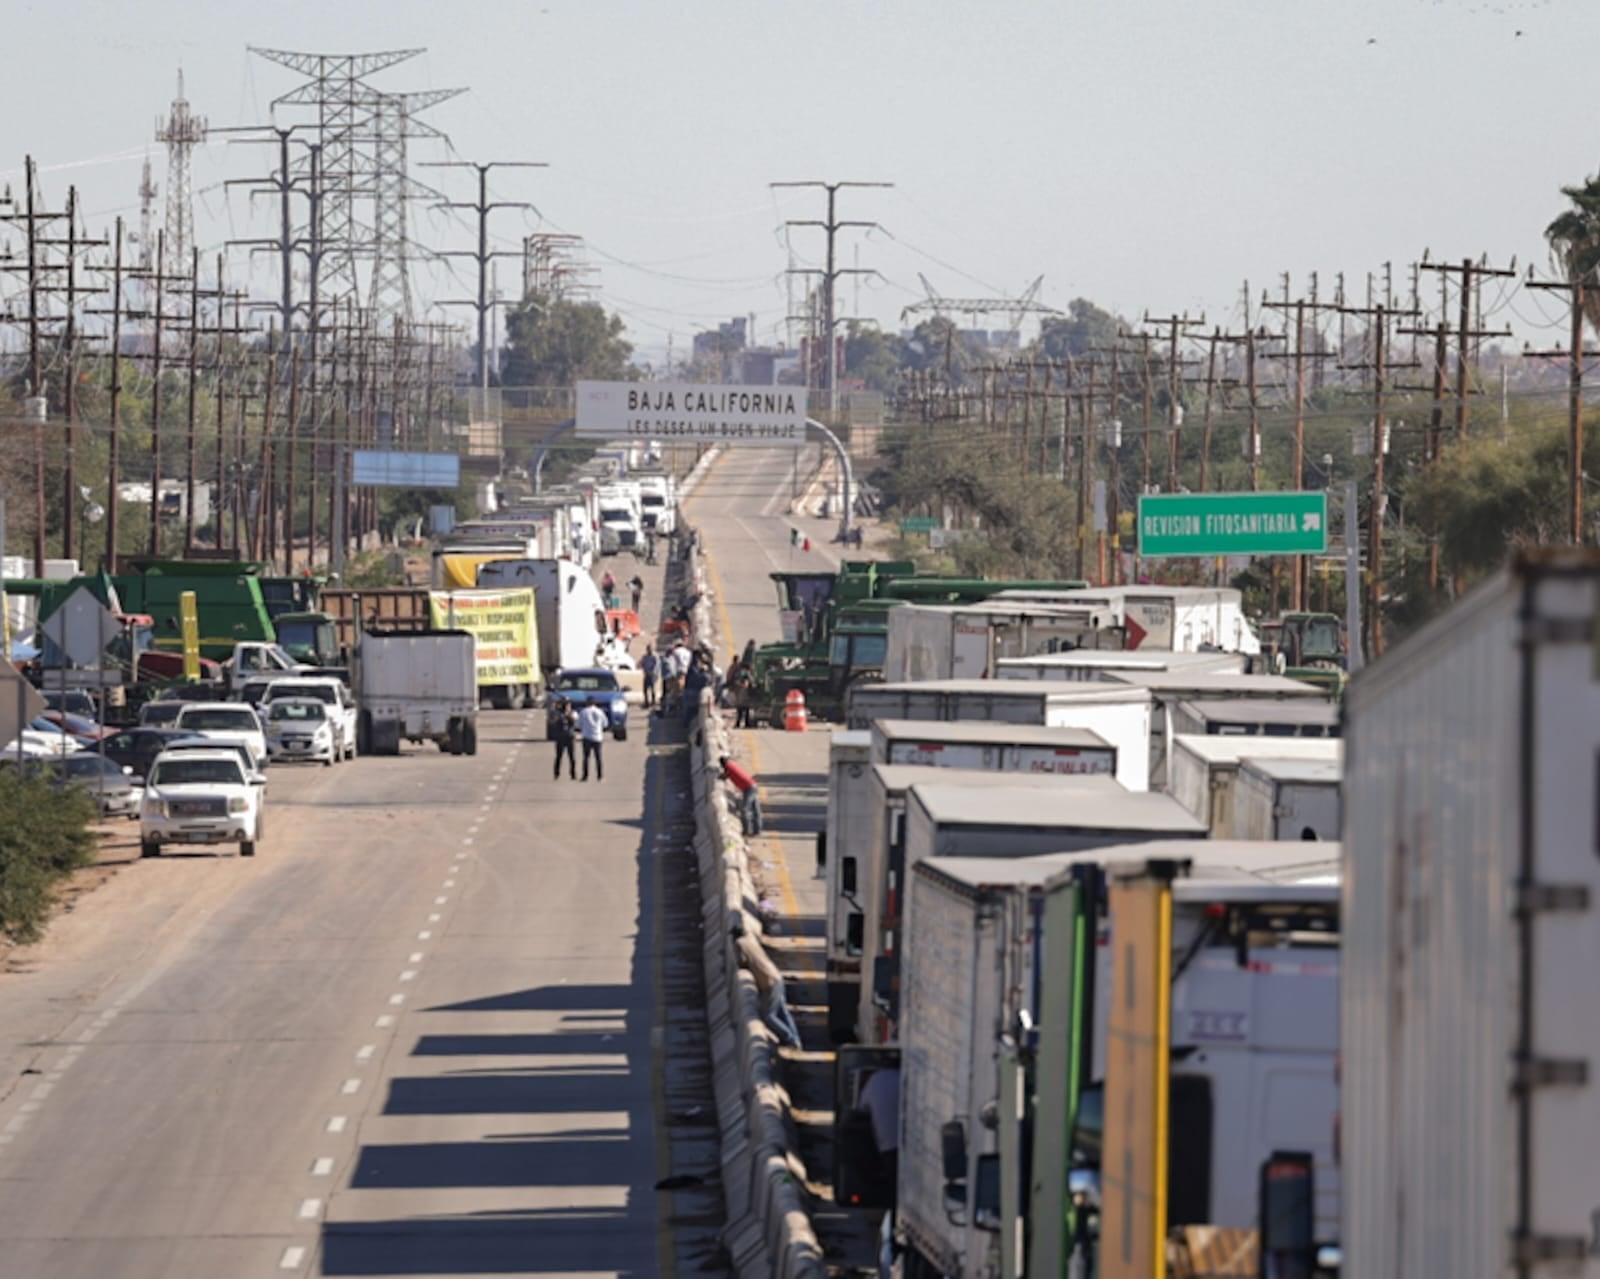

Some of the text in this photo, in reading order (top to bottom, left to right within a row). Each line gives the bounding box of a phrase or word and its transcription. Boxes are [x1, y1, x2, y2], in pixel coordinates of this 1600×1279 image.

[627, 390, 676, 411] BAJA
[684, 392, 796, 414] CALIFORNIA
[627, 420, 650, 435] LES
[655, 420, 694, 436] DESEA
[721, 422, 754, 437] BUEN
[759, 423, 796, 438] VIAJE
[1144, 513, 1298, 536] REVISION FITOSANITARIA
